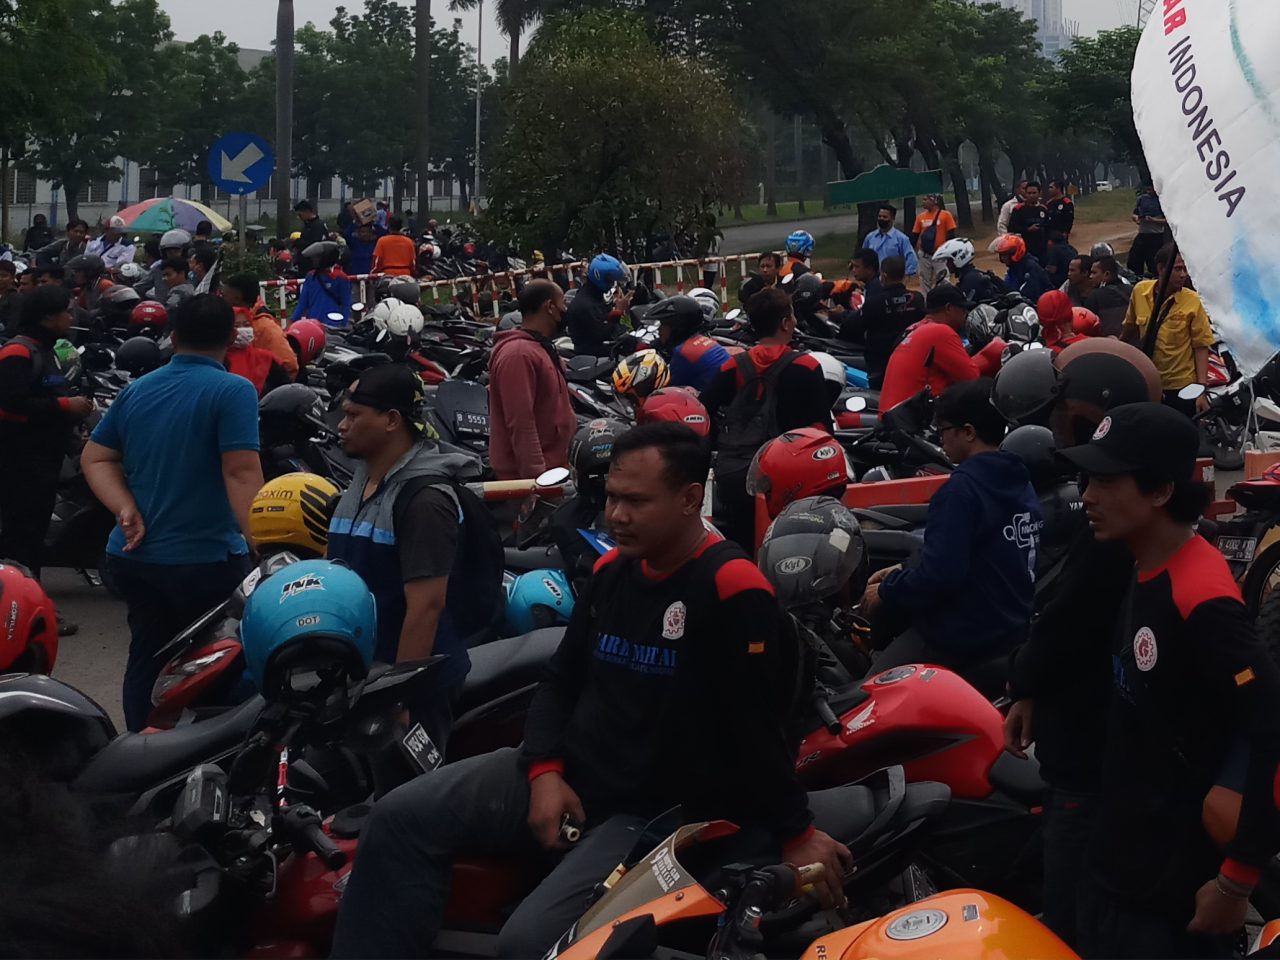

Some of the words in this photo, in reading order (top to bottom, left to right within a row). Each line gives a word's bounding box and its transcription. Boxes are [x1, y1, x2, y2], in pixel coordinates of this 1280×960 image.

[1168, 35, 1246, 218] INDONESIA
[282, 577, 322, 593] INK
[7, 600, 18, 640] GORILLA
[297, 616, 319, 627] DOT
